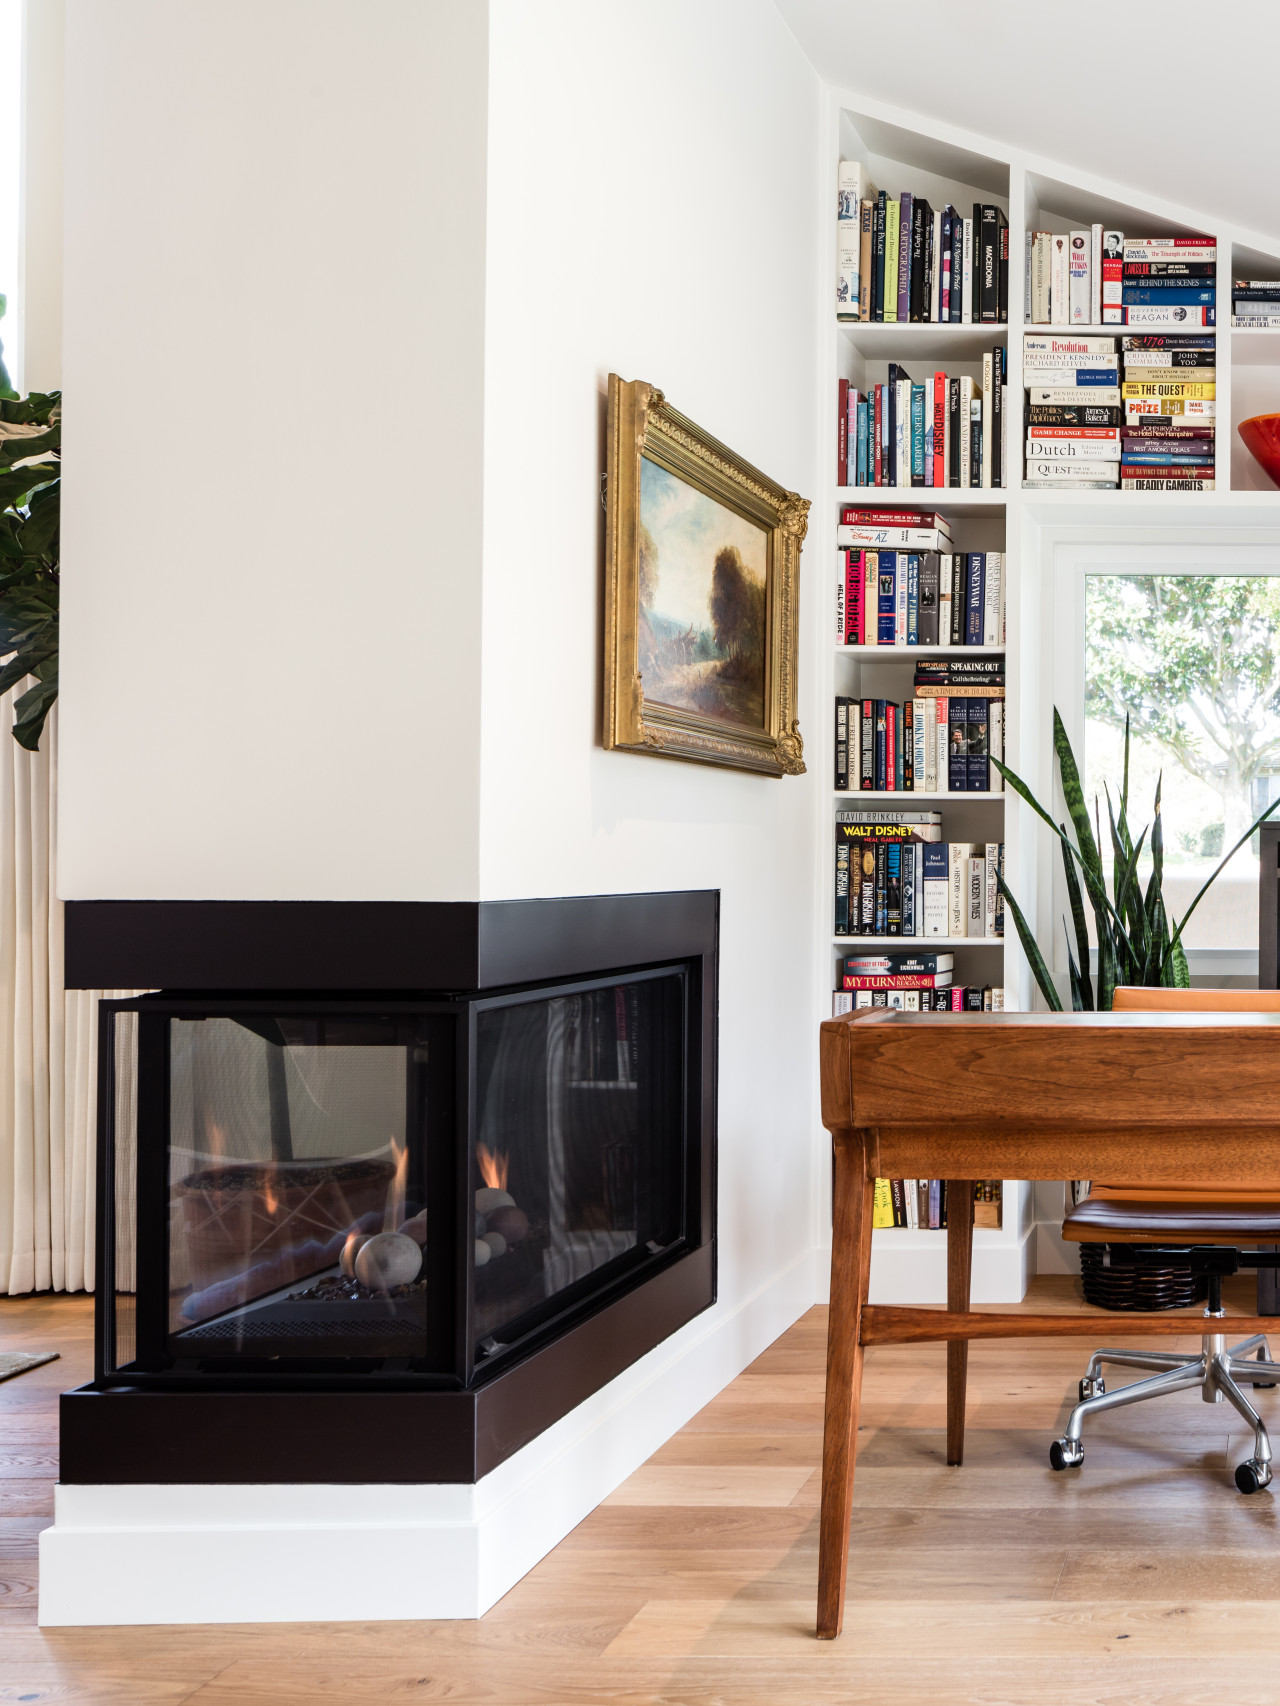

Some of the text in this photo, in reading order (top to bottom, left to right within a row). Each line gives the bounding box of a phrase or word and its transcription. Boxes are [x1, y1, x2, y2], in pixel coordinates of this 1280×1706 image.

[863, 206, 872, 232] TEXAS
[877, 232, 885, 255] PALACE
[899, 222, 908, 295] CARTOGRAPHIA
[1072, 253, 1085, 261] WHAT
[985, 245, 993, 288] MACEDONIA
[1124, 264, 1150, 275] LANDSLIDE
[1052, 341, 1088, 352] Revolution
[1144, 336, 1166, 347] 1776
[1141, 385, 1185, 396] THE QUEST
[1129, 404, 1159, 414] PRIZE
[914, 393, 923, 474] WESTERN GARDEN
[934, 403, 944, 456] WALT DISNEY
[1030, 442, 1076, 456] Dutch
[1037, 464, 1072, 476] QUEST
[1136, 480, 1203, 490] DEADLY GAMBITS
[852, 531, 873, 542] Disney
[971, 556, 980, 608] DISNEYWAR
[837, 602, 843, 610] OF
[847, 563, 860, 633] TOO BIG TO FAIL
[951, 663, 999, 671] SPEAKING OUT
[915, 714, 925, 779] LOOKING FORWARD
[840, 813, 904, 821] DAVID BRINKLEY
[843, 825, 915, 836] WALT DISNEY
[888, 844, 900, 877] RUDY!
[836, 845, 848, 896] JOHN GRISHAM
[987, 846, 996, 914] Paul Johnson Intellectuals
[862, 881, 872, 923] JOHN GRISHAM
[972, 875, 980, 919] MODERN TIMES
[846, 977, 896, 987] MY TURN
[881, 1185, 891, 1208] Cook
